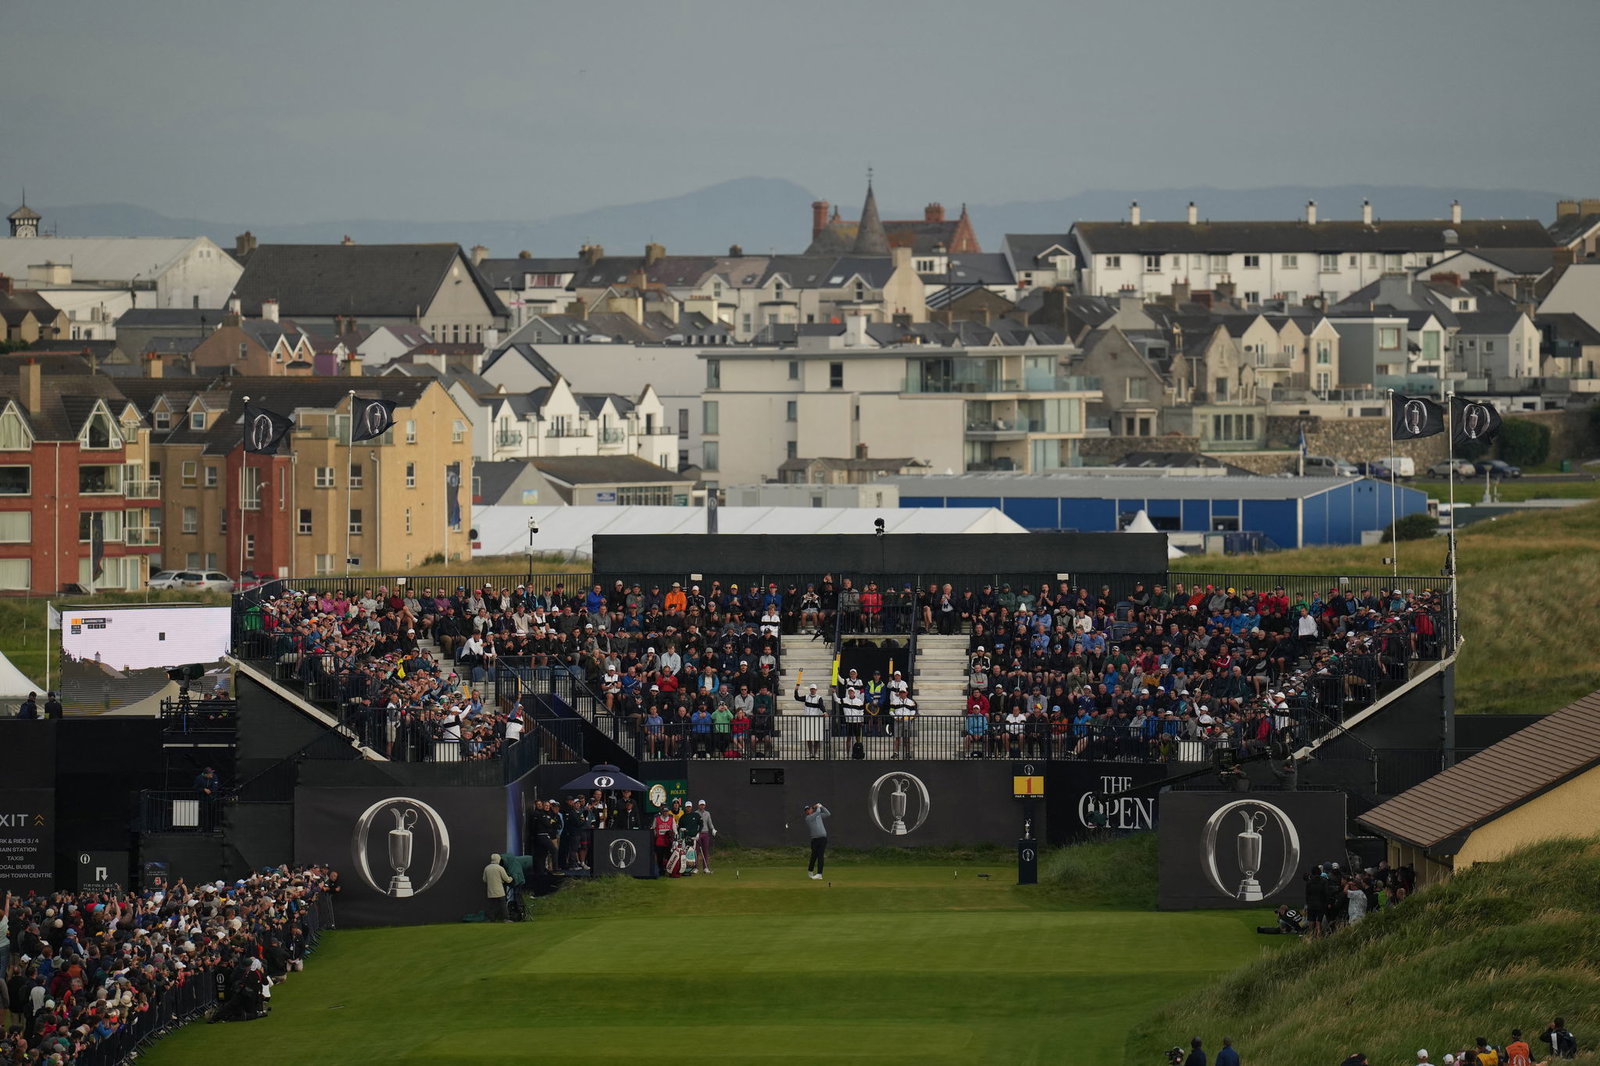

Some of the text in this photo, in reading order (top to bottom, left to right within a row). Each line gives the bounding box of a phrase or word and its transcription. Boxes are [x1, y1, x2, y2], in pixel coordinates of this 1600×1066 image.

[1026, 777, 1032, 793] 1
[1101, 776, 1132, 794] THE
[1078, 791, 1155, 830] OPEN
[0, 814, 29, 827] XIT
